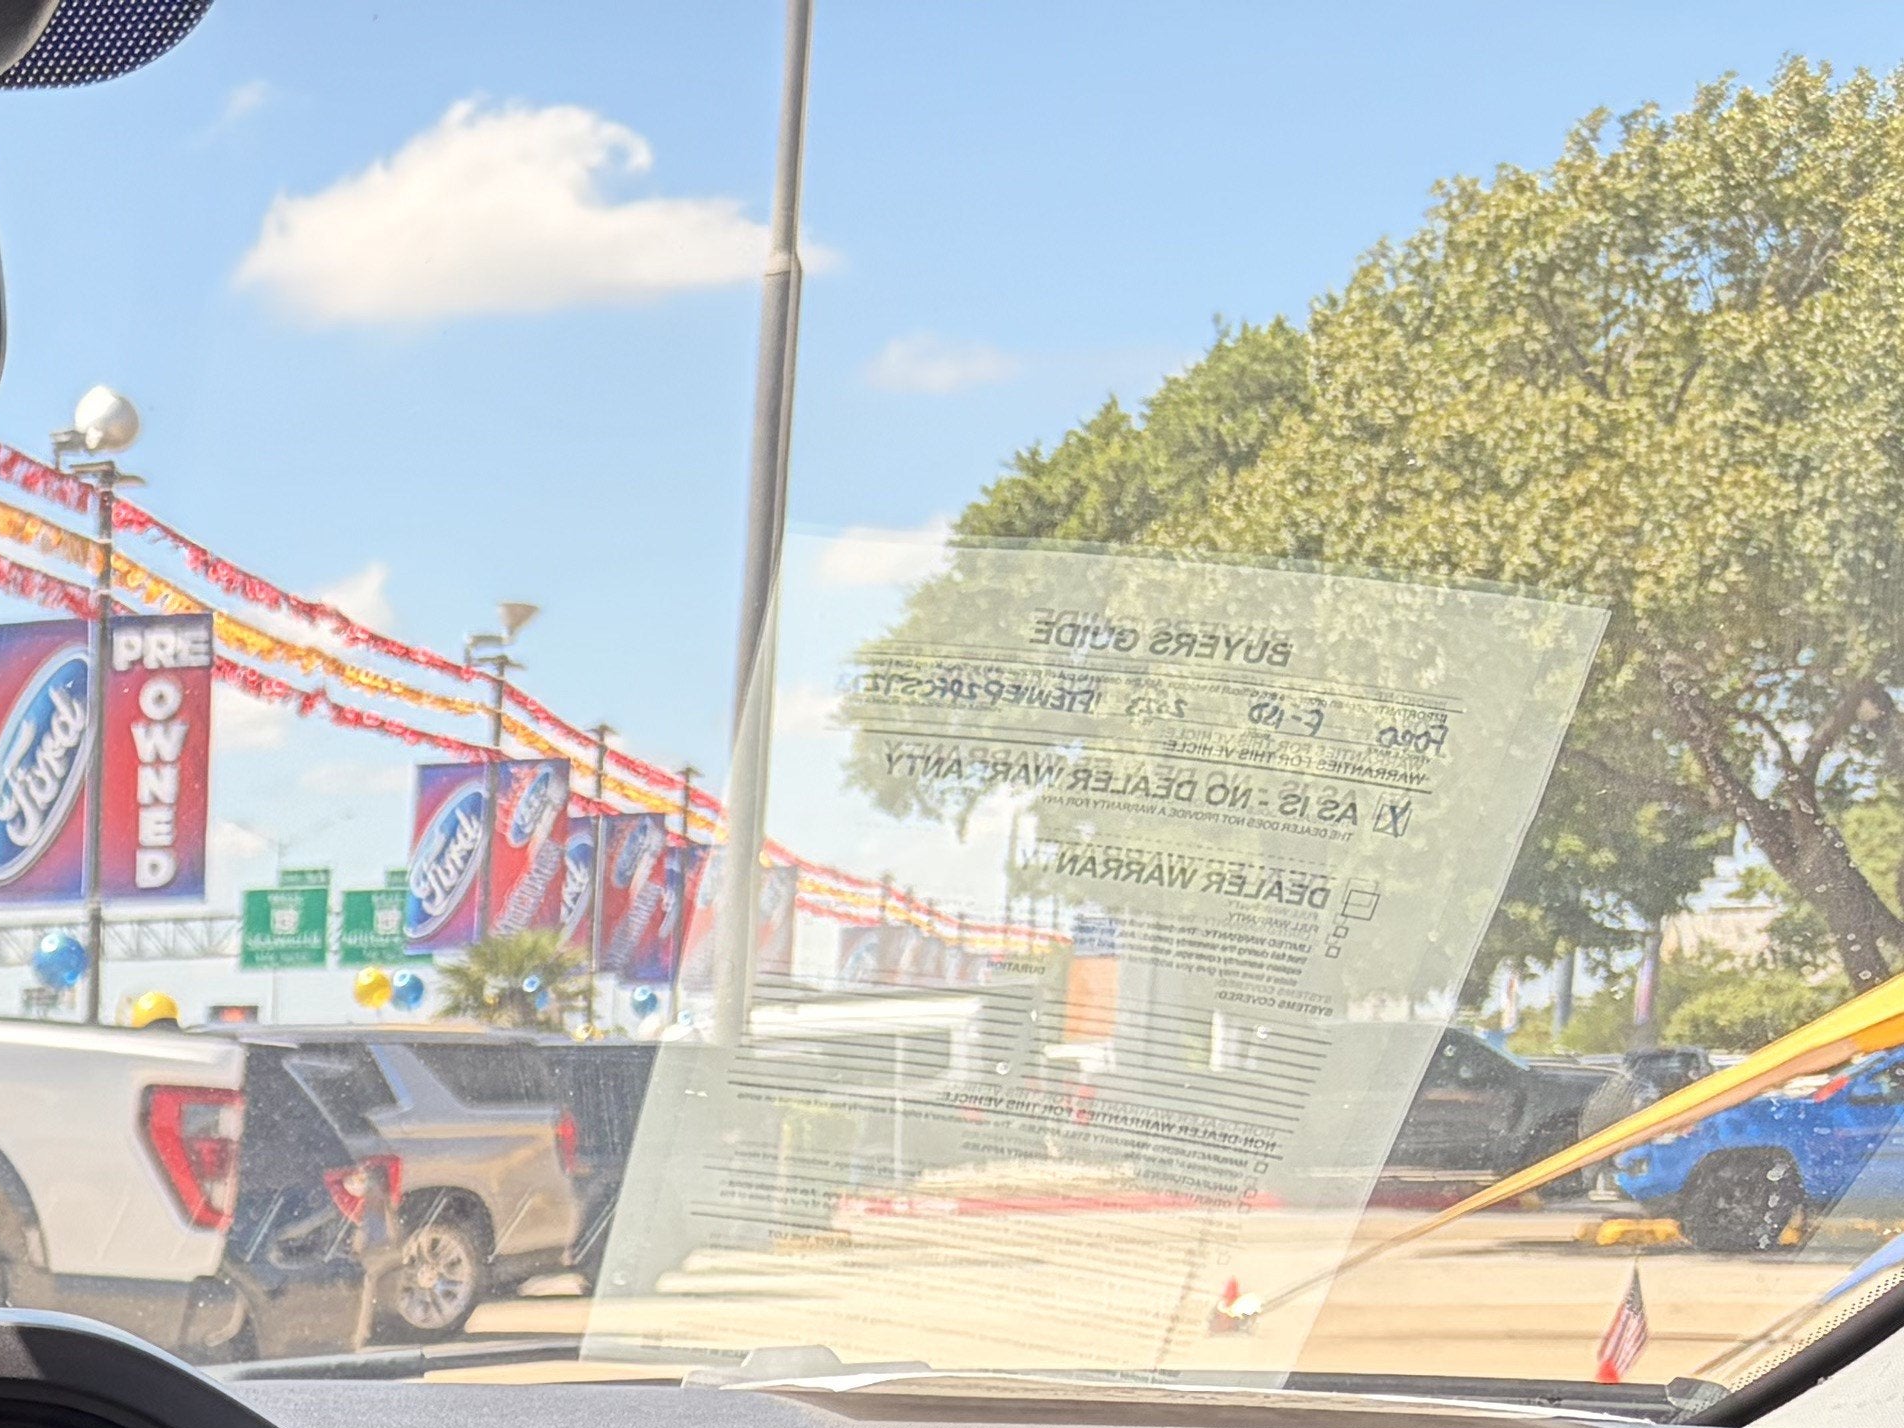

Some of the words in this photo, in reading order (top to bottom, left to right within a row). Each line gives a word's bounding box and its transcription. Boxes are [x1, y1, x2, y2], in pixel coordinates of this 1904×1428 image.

[112, 625, 211, 671] PRE
[131, 674, 189, 889] OWNED
[409, 808, 482, 916] Ford
